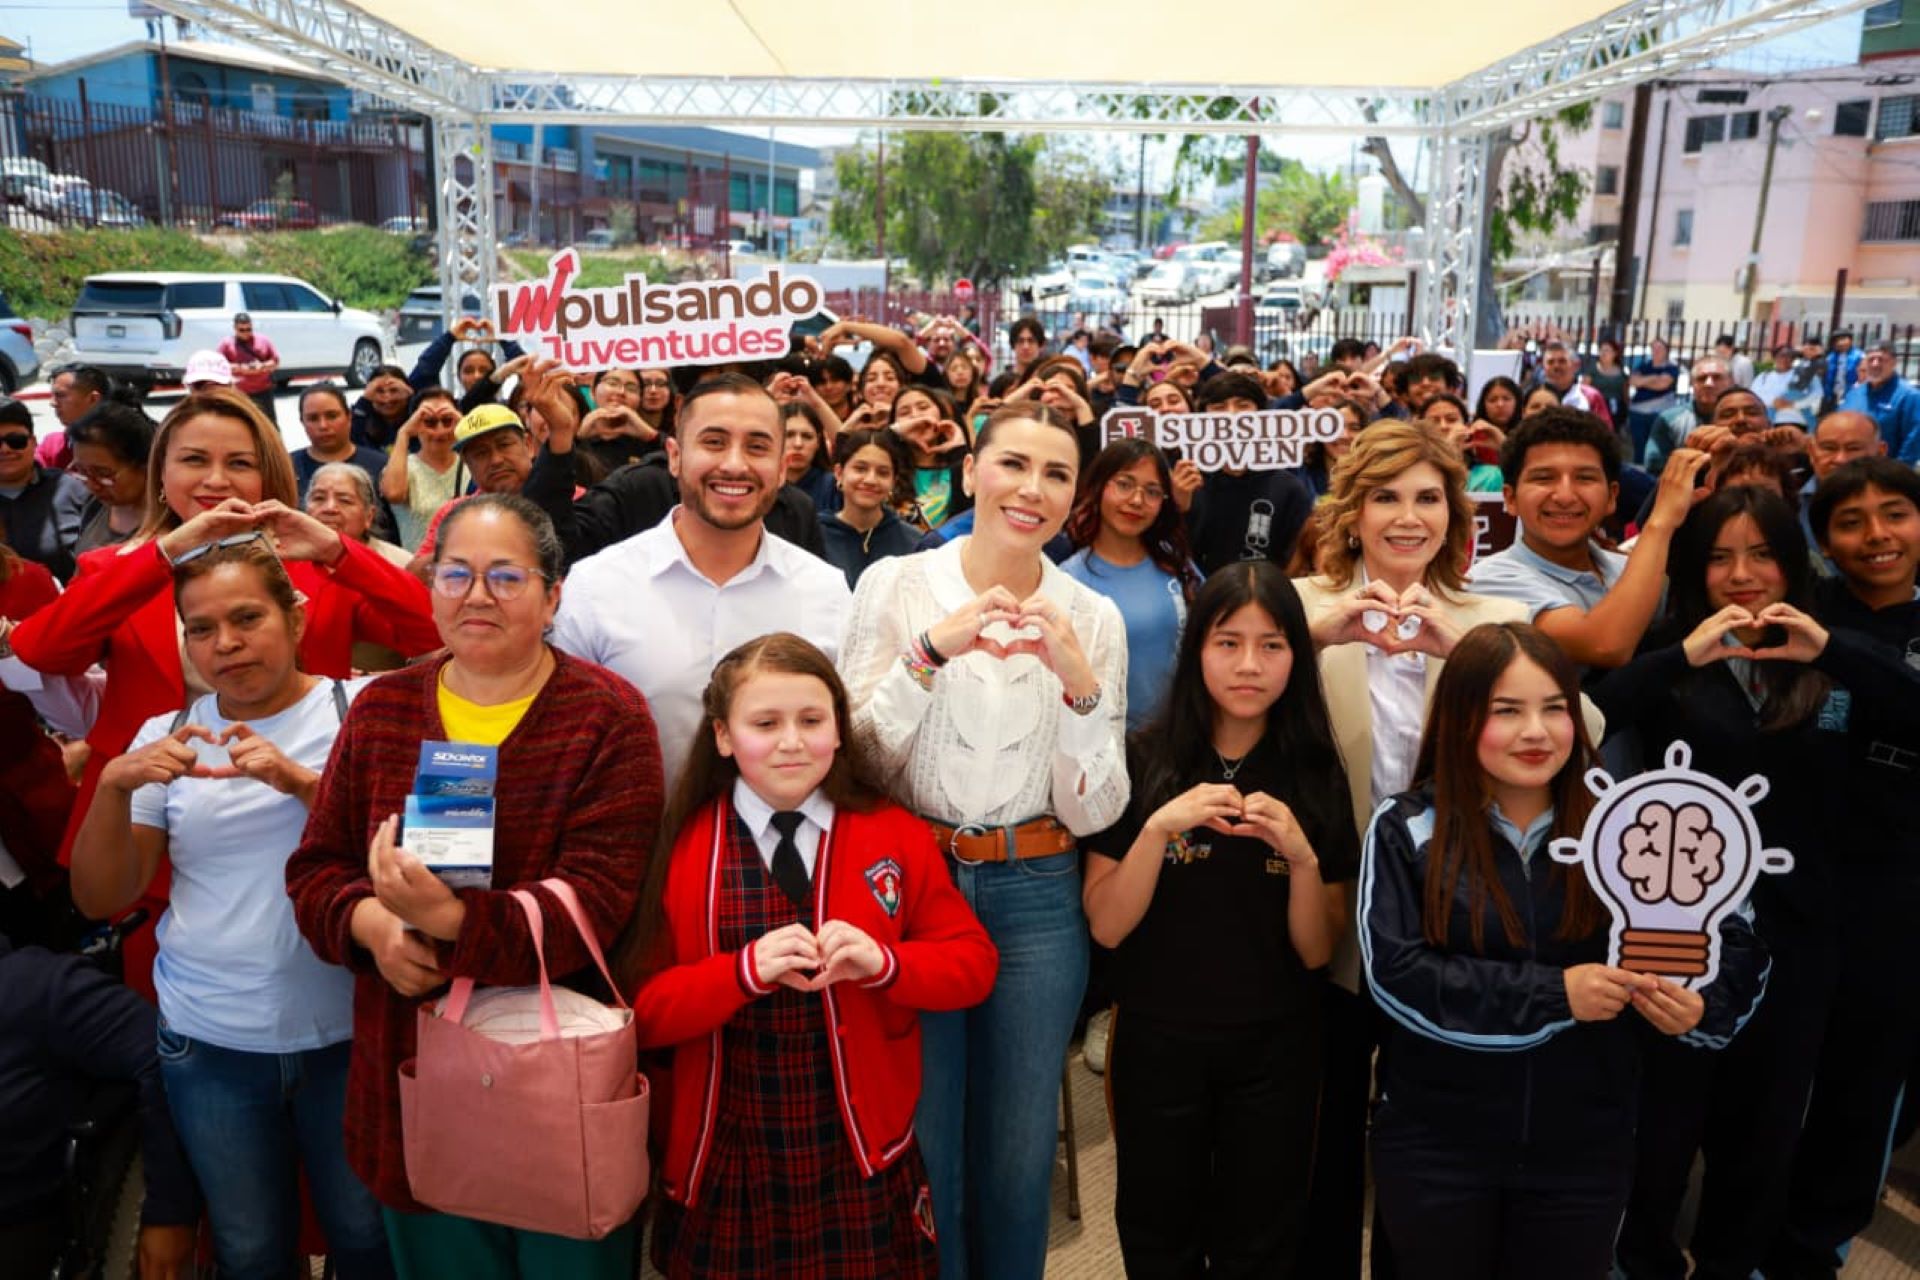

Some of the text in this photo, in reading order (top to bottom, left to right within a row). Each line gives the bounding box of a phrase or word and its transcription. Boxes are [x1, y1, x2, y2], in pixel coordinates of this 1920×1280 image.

[543, 323, 785, 366] Juventudes
[1162, 412, 1339, 442] SUBSIDIO
[1184, 440, 1299, 467] JOVEN
